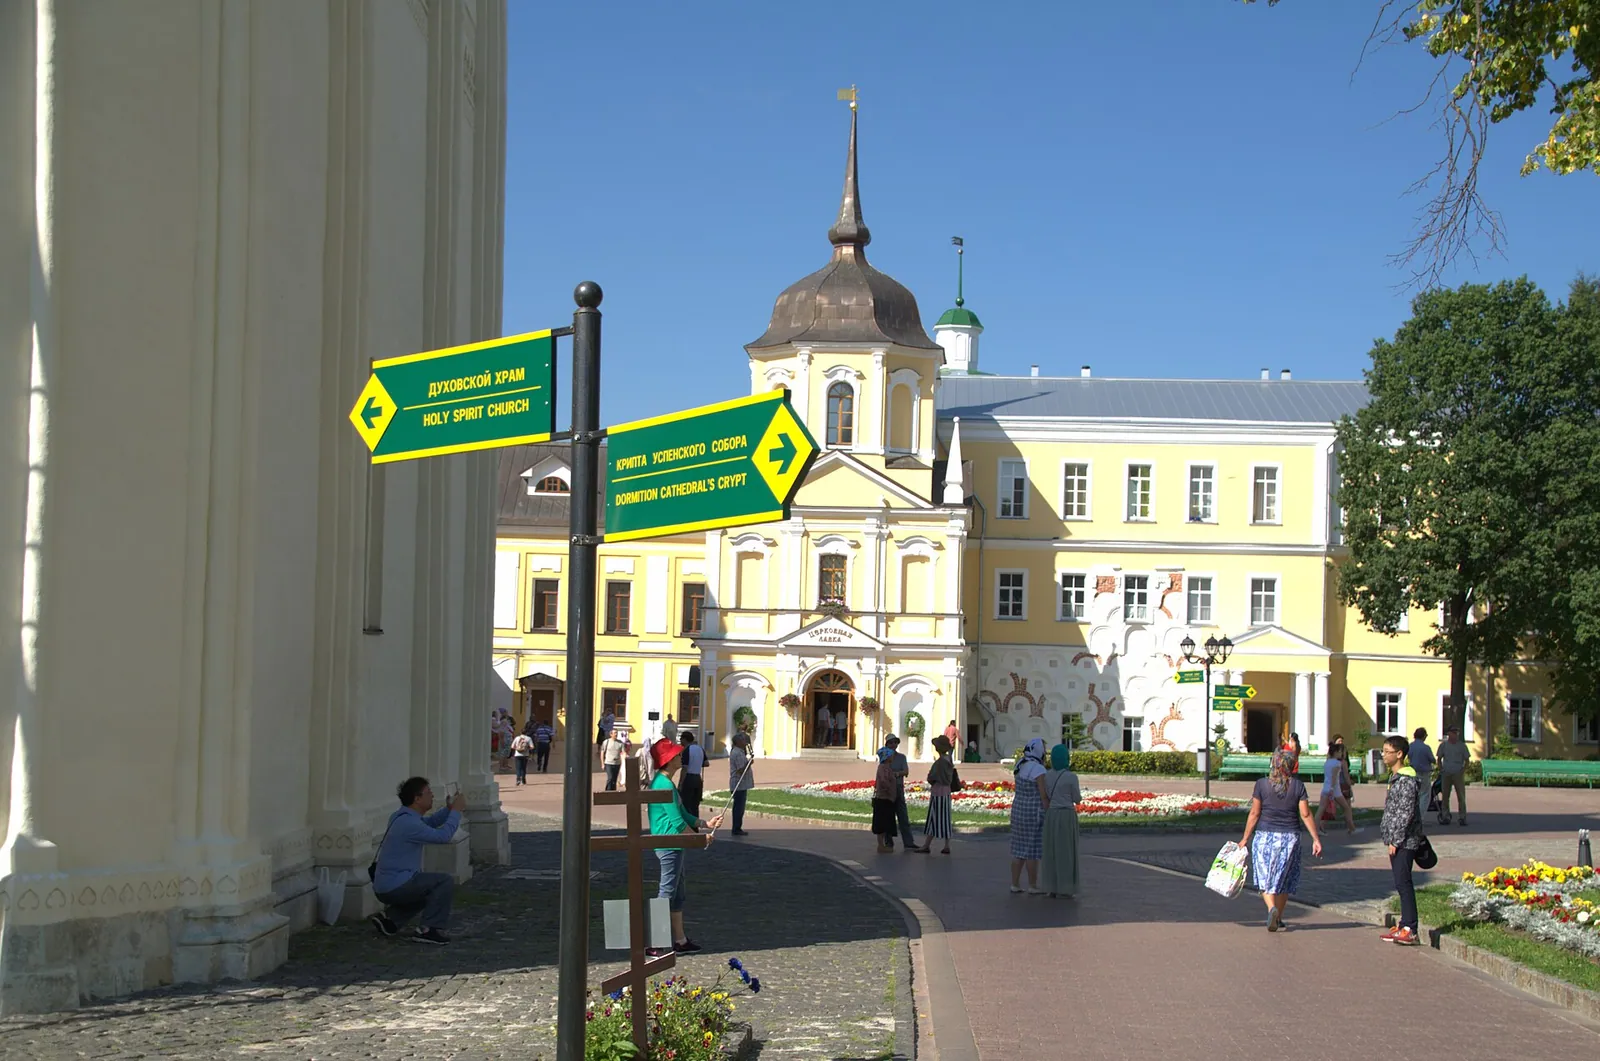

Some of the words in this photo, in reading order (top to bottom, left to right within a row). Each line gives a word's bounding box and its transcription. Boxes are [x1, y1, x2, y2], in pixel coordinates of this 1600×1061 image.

[428, 370, 491, 397] ДУХОВСКОЙ
[494, 367, 525, 385] ХРАМ
[423, 410, 450, 427] HOLY
[453, 405, 485, 423] SPIRIT
[487, 398, 530, 418] CHURCH
[616, 454, 648, 471] КРИПТА
[652, 442, 706, 465] УСПЕНСКОГО
[711, 434, 748, 453] СОБОРА
[615, 487, 659, 507] DORMITION
[660, 477, 716, 499] CATHEDRAL'S
[717, 472, 748, 491] CRYPT
